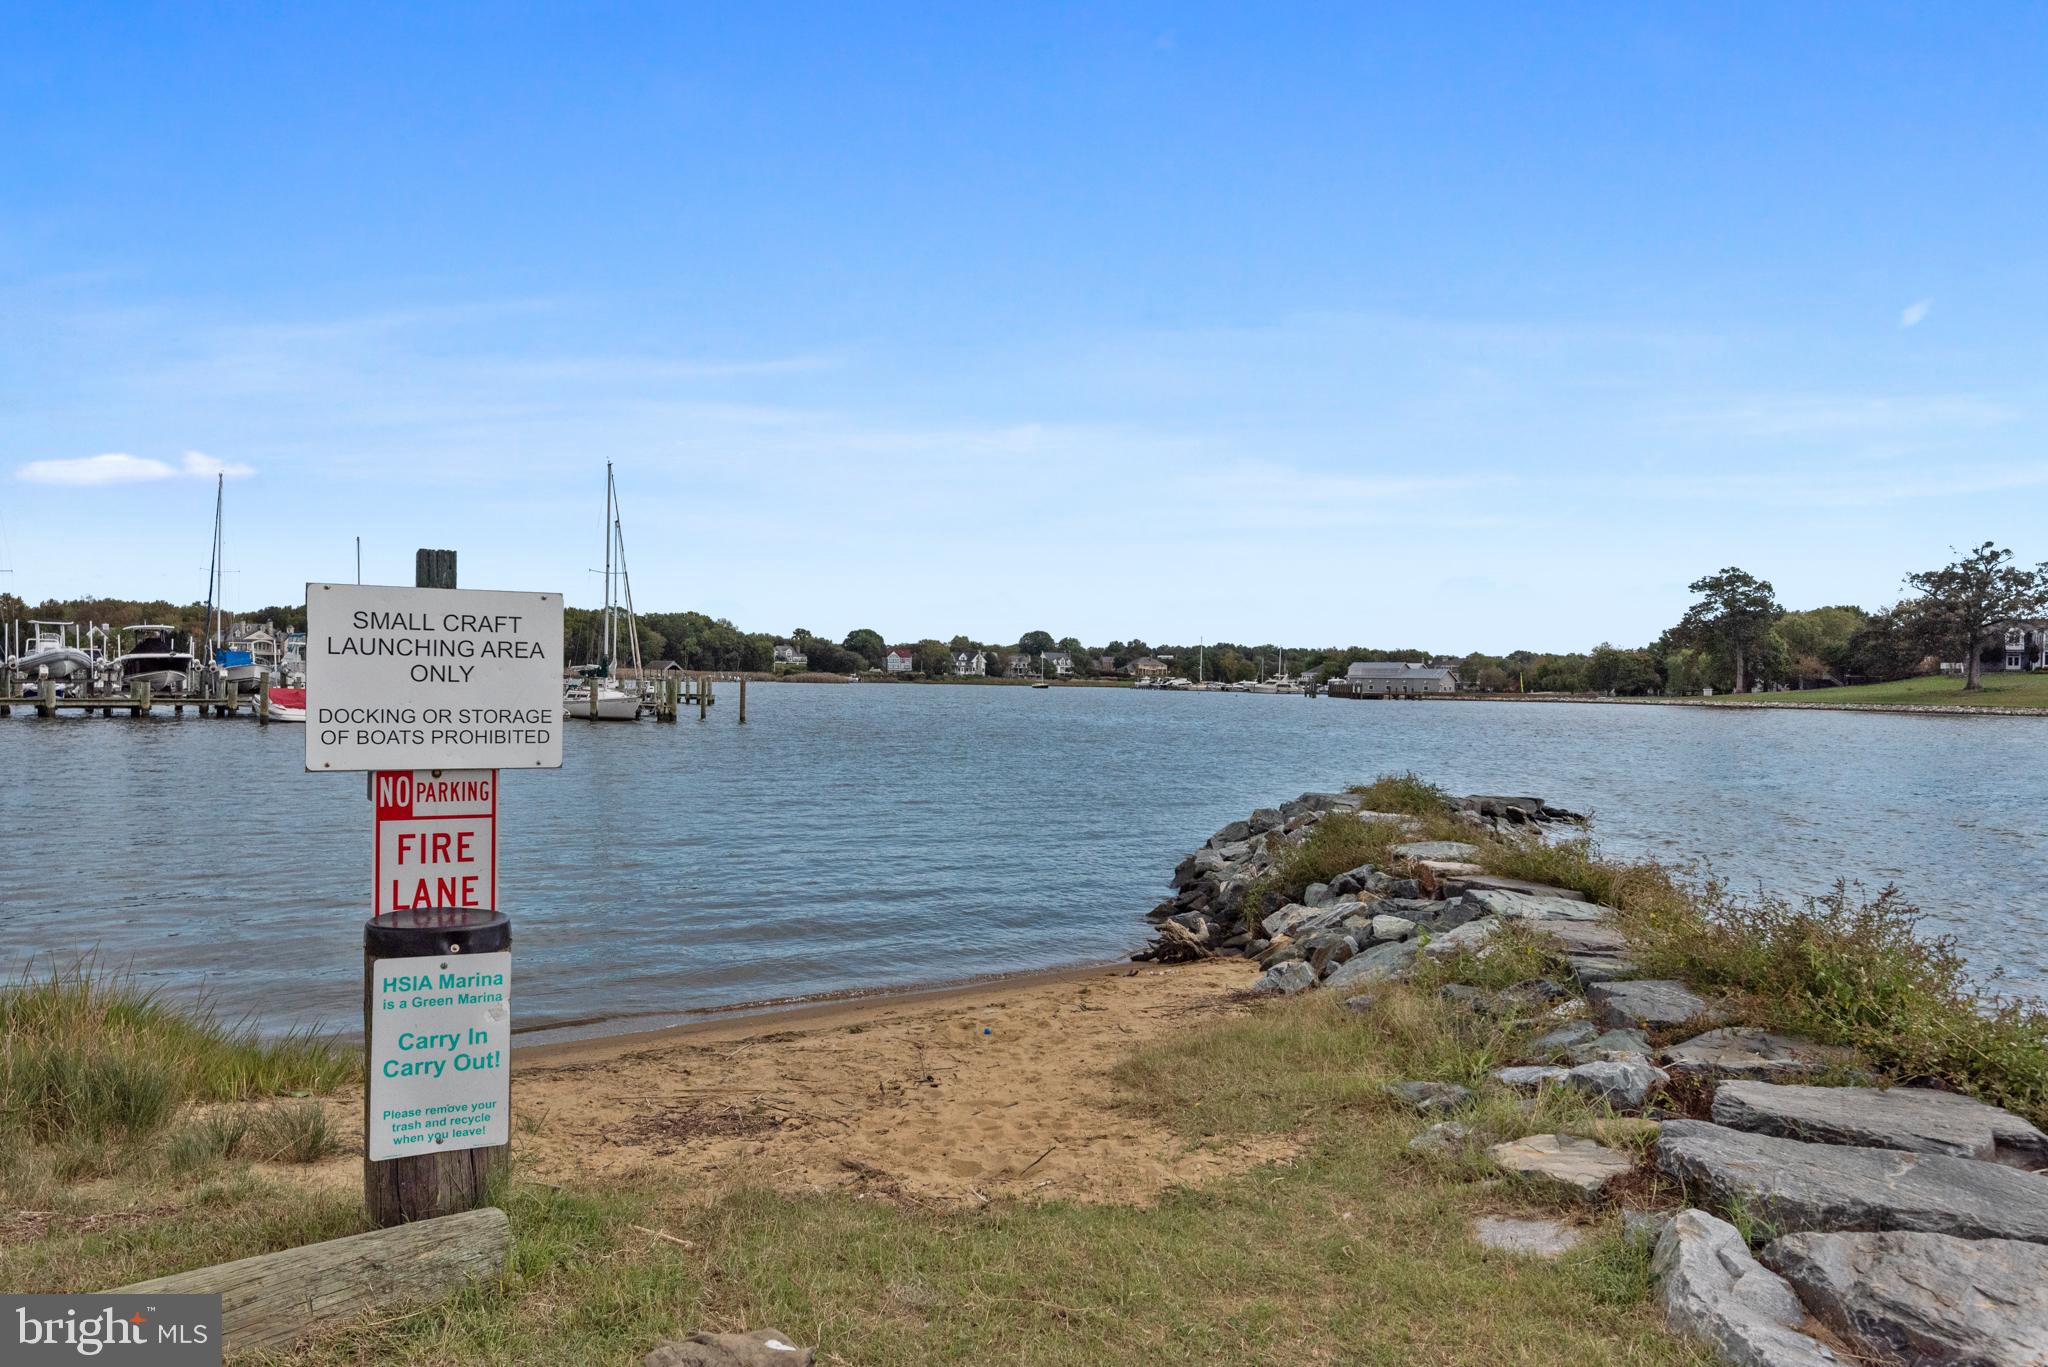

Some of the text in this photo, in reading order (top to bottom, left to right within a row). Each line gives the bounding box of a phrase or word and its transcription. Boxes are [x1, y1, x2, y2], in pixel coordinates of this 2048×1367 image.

[353, 611, 522, 633] SMALL CRAFT
[327, 636, 545, 659] LAUNCHING AREA
[410, 664, 475, 683] ONLY
[319, 708, 553, 724] DOCKING OR STORAGE
[320, 729, 550, 745] OF BOATS PROHIBITED
[380, 776, 489, 808] NO PARKING
[398, 832, 474, 865] FIRE
[392, 876, 479, 910] LANE
[383, 972, 503, 993] HSIA Marina
[383, 992, 503, 1010] is a Green Marina
[398, 1027, 488, 1052] Carry In
[383, 1050, 500, 1078] Carry Out!
[383, 1101, 496, 1120] Please remove your
[392, 1113, 491, 1132] trash and recycle
[393, 1126, 486, 1145] when you leave!
